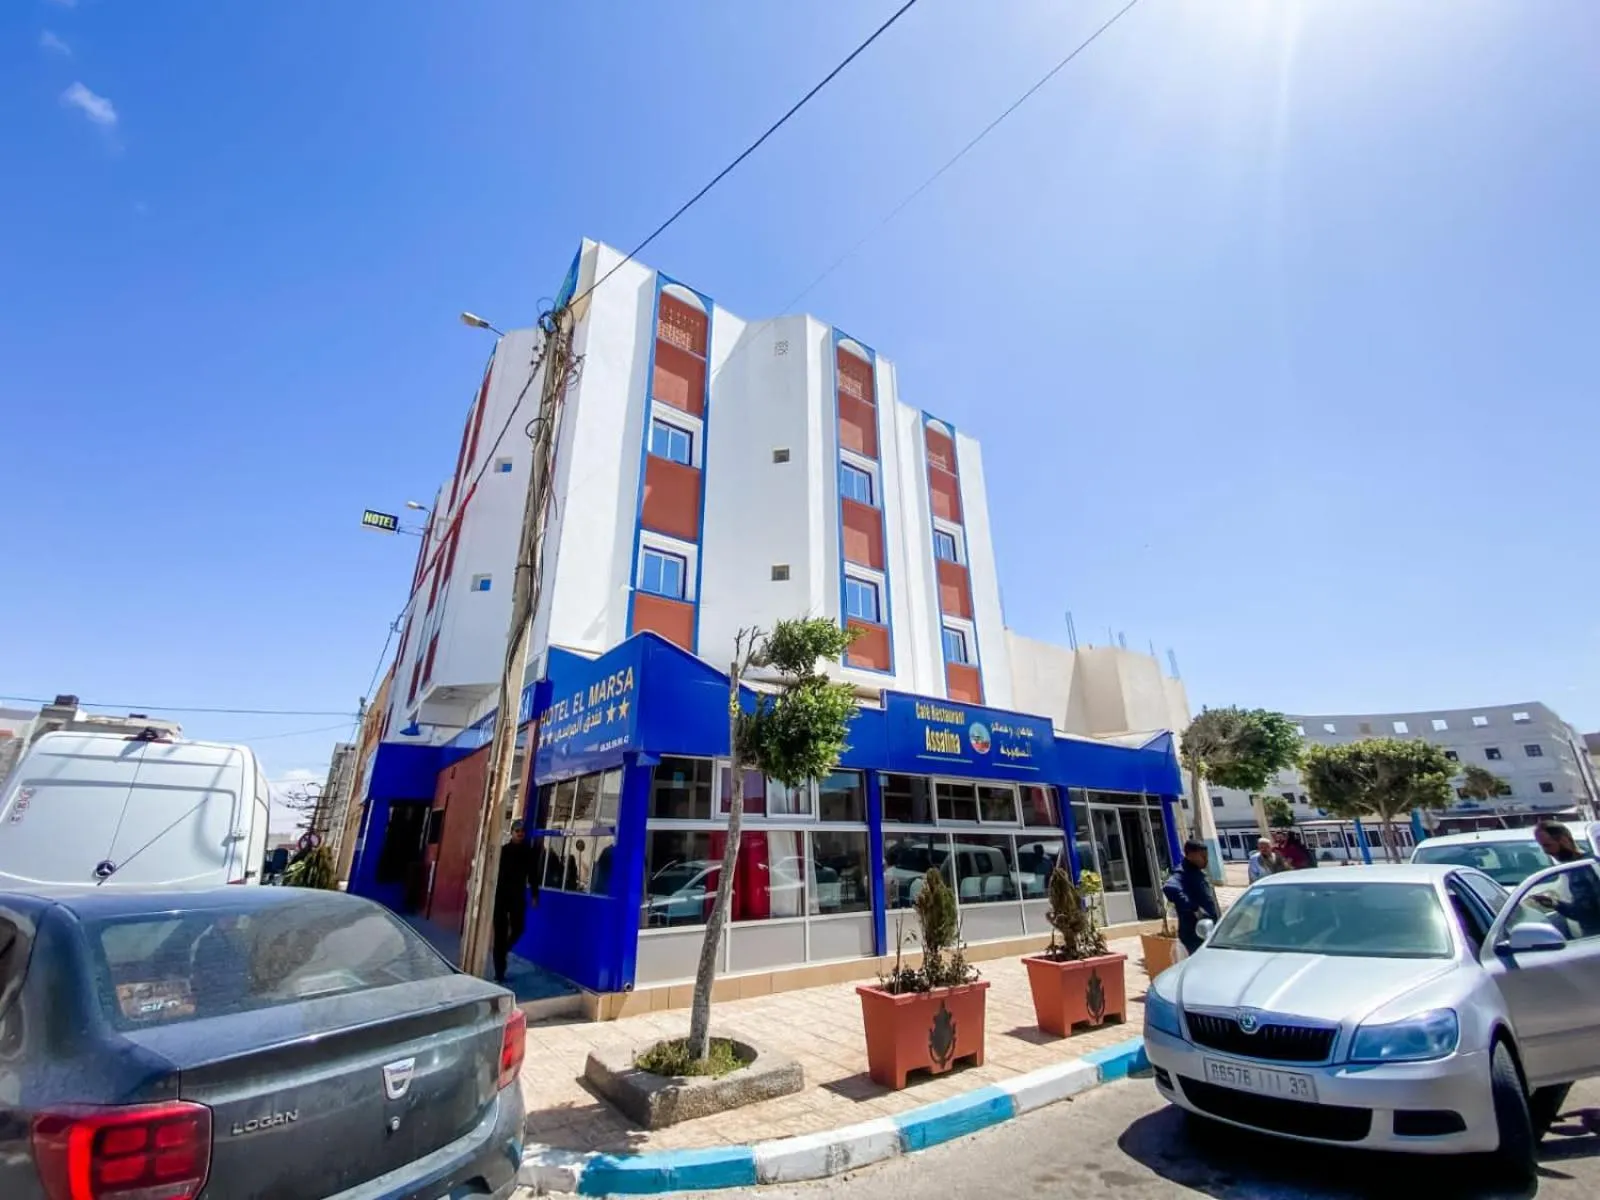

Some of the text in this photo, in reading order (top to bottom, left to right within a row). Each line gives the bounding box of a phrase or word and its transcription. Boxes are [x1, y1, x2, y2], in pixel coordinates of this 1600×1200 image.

[540, 698, 569, 729] HOTEL
[573, 690, 585, 715] EL
[588, 666, 634, 708] MARSA
[931, 704, 965, 725] Restaurant
[231, 1109, 299, 1136] LOGAN
